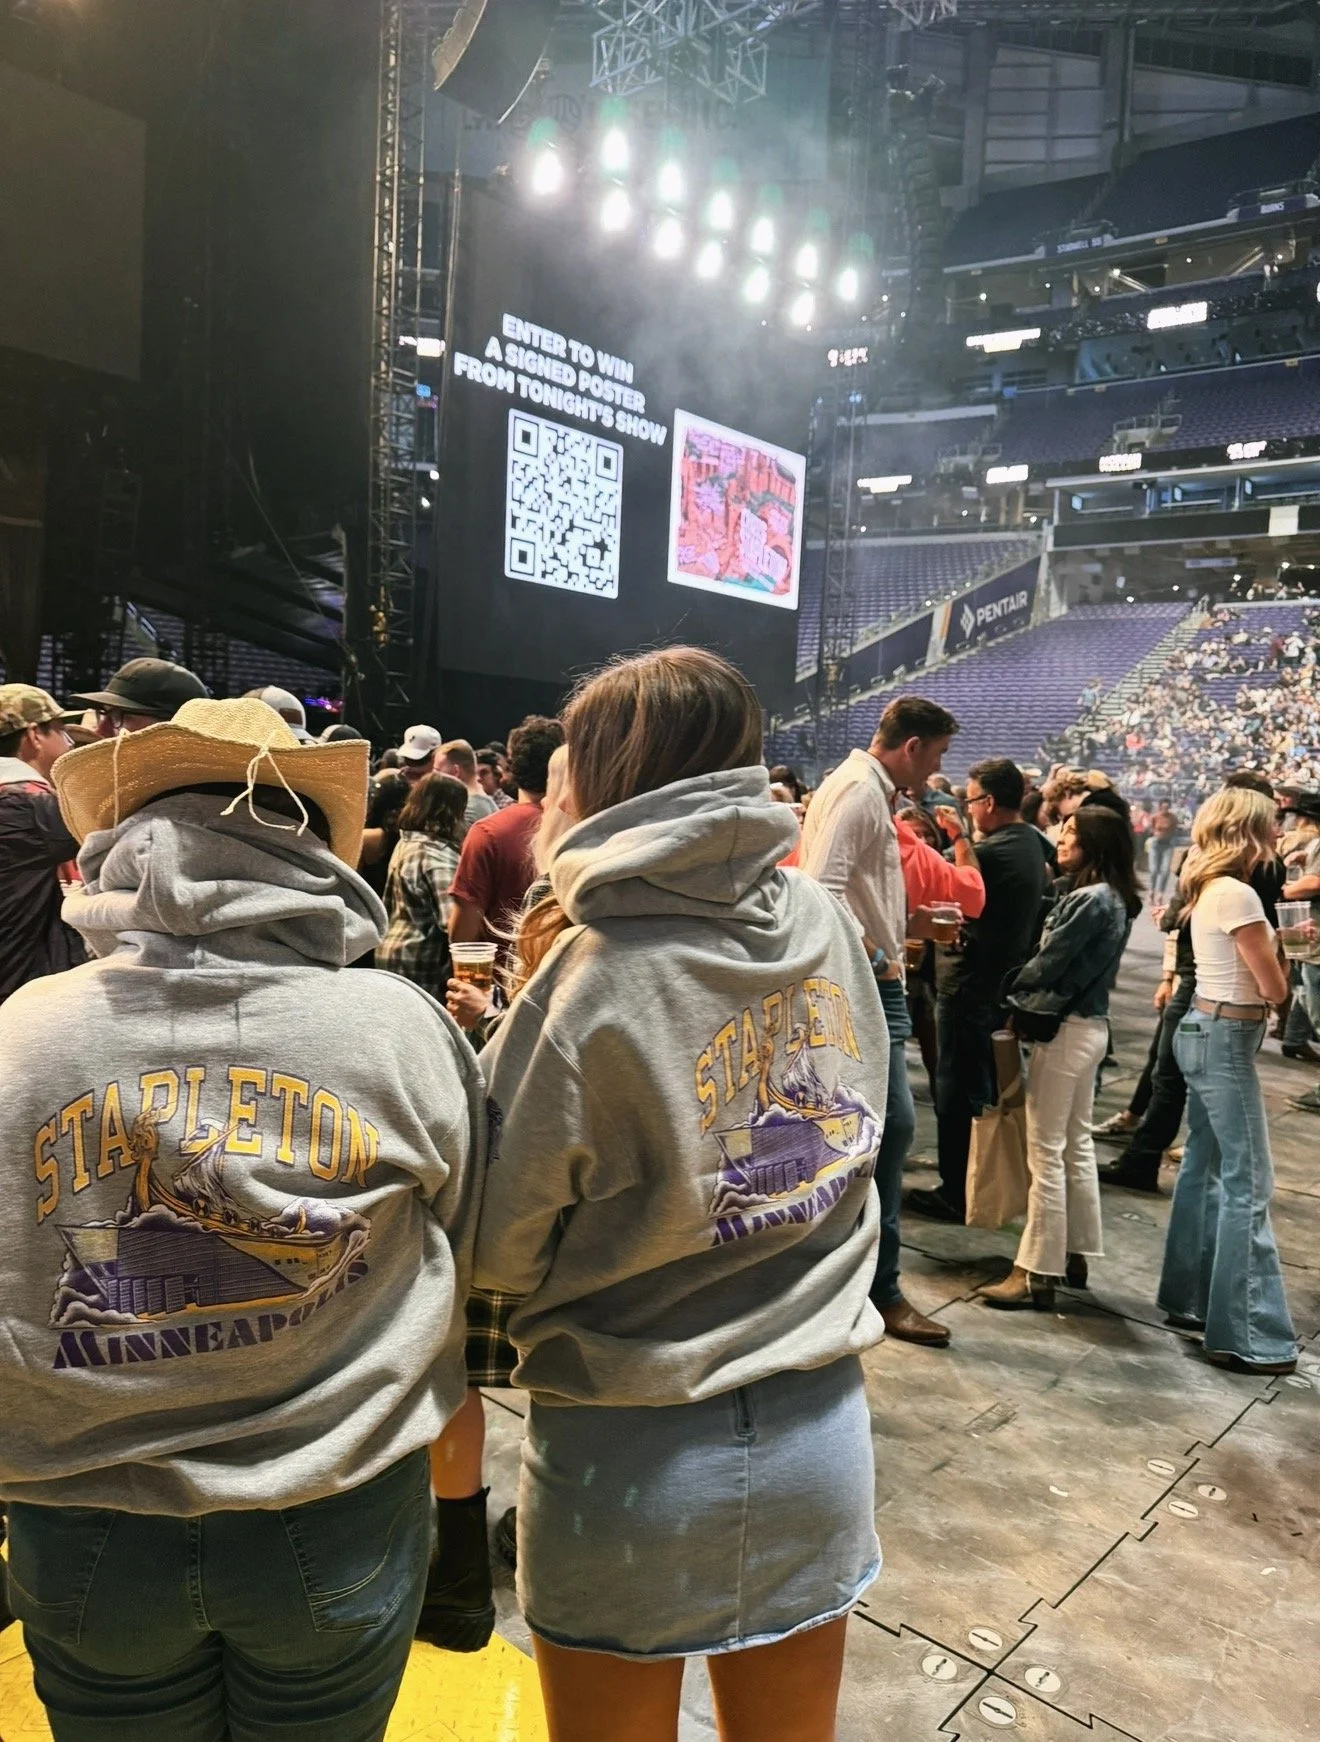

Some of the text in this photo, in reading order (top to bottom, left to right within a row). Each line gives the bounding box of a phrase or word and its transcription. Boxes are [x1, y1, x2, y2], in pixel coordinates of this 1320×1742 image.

[484, 336, 502, 361] A
[505, 343, 577, 387] SIGNED
[578, 369, 646, 414] POSTER
[503, 313, 634, 384] ENTER TO WIN
[453, 352, 667, 446] FROM TONIGHT'S SHOW
[976, 590, 1028, 627] PENTAIR
[694, 976, 863, 1138] STAPLET
[34, 1064, 381, 1226] STAPLETON
